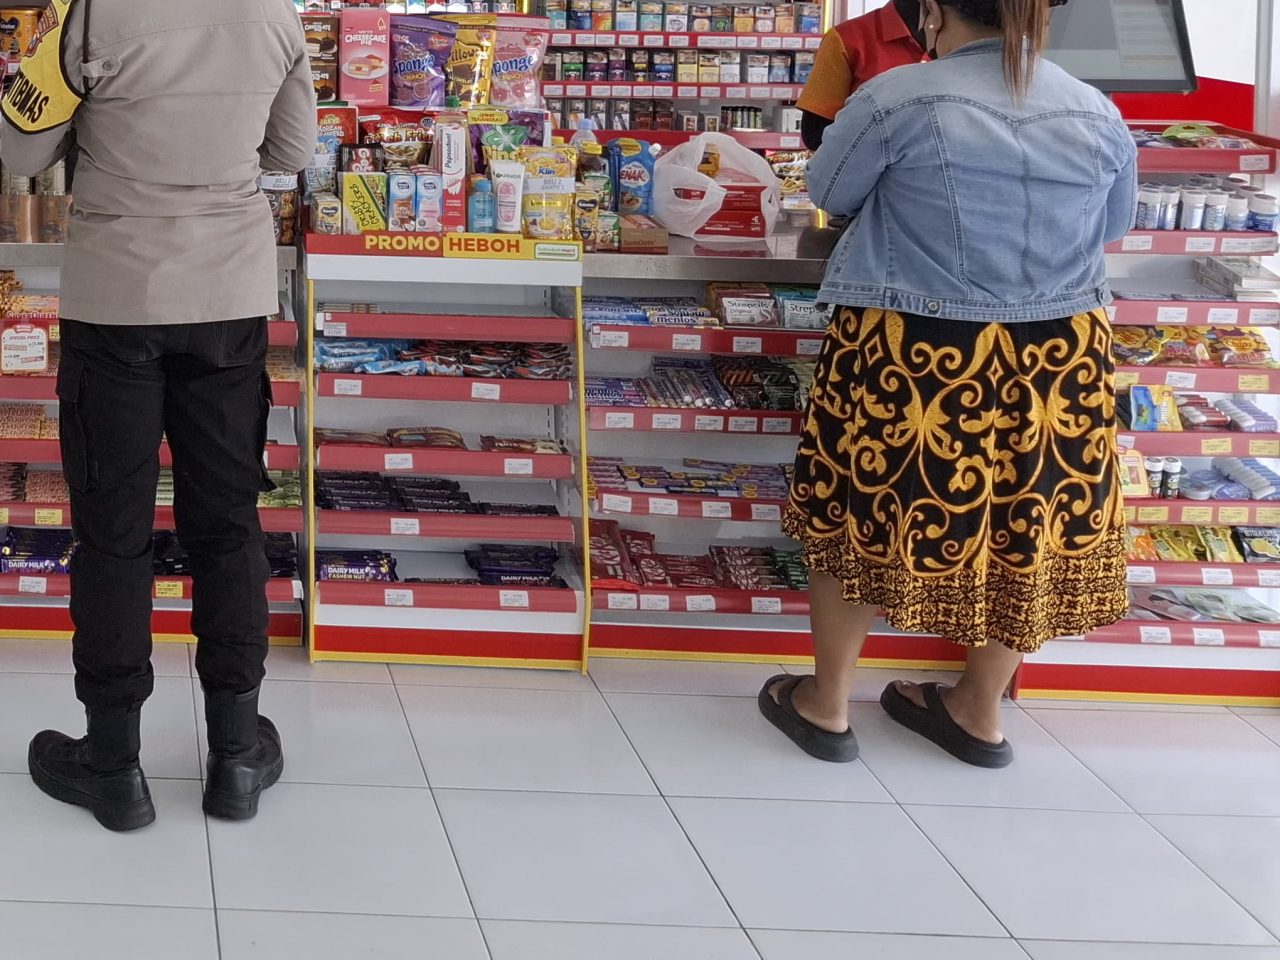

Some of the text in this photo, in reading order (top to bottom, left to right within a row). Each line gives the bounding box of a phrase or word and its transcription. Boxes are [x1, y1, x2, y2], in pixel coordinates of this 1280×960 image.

[345, 35, 386, 43] CHEESECAKE
[393, 55, 434, 74] Sponge
[493, 55, 534, 75] ponge
[445, 133, 453, 168] Pepsodent
[539, 167, 555, 175] Klin
[349, 183, 379, 225] CRACKERS
[349, 199, 369, 227] CRISPY
[365, 235, 440, 251] PROMO
[449, 237, 520, 253] HEBOH
[788, 302, 818, 314] Strep
[657, 315, 697, 324] mentos
